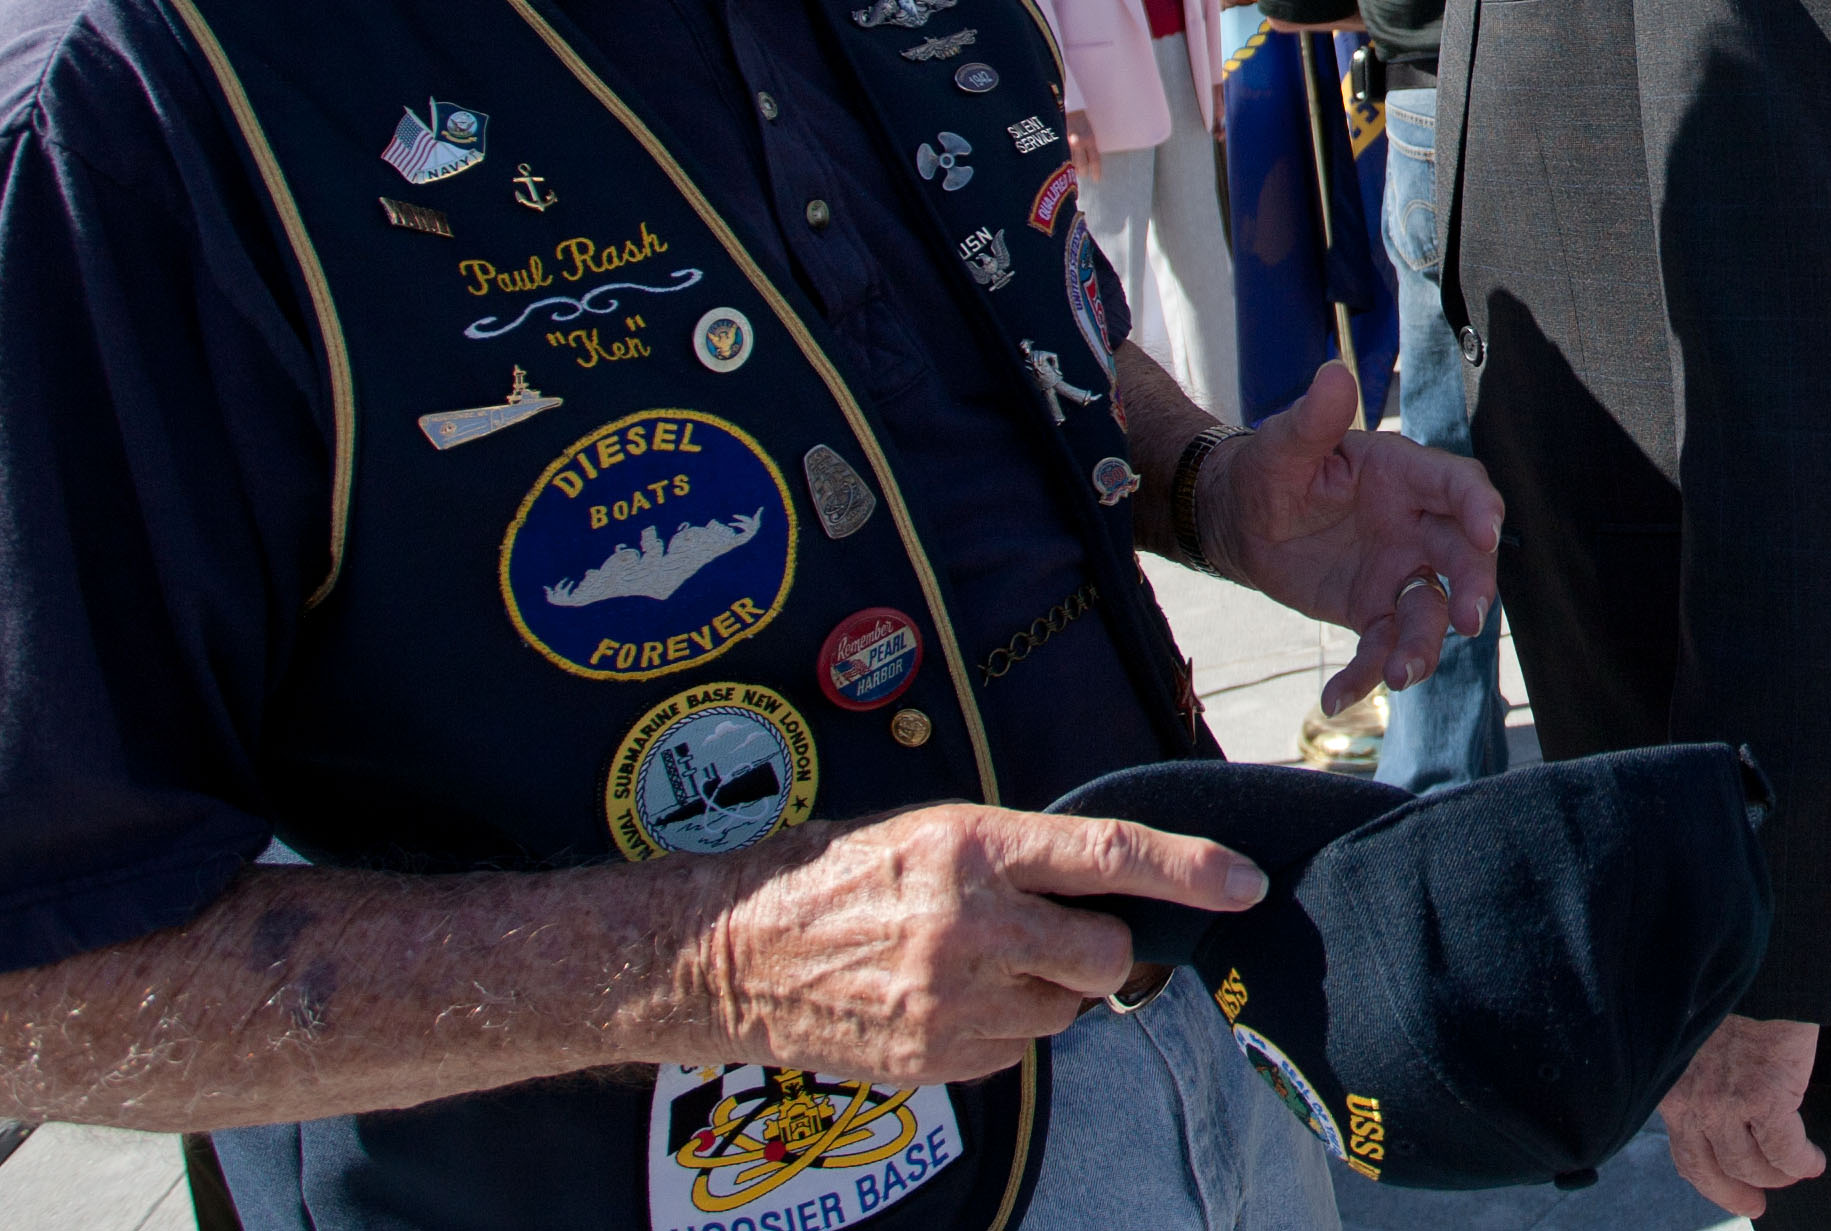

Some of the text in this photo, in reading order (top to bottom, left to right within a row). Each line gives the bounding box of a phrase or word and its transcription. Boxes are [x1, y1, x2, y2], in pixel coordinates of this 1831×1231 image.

[1007, 116, 1044, 139] SILENT
[1015, 128, 1060, 154] SERVICE
[428, 156, 471, 179] NAVY
[459, 222, 668, 297] Paul Rash
[957, 226, 993, 260] USN
[552, 421, 702, 499] DIESEL
[589, 474, 691, 530] BOATS
[590, 596, 765, 670] FOREVER
[837, 620, 895, 661] Remember
[869, 631, 908, 668] PEARL
[856, 658, 903, 697] HARBOR
[614, 687, 812, 861] NAVAL SUBMARINE BASE NEW LONDON
[1346, 1093, 1385, 1161] USS
[671, 1124, 949, 1231] OSIER BASE
